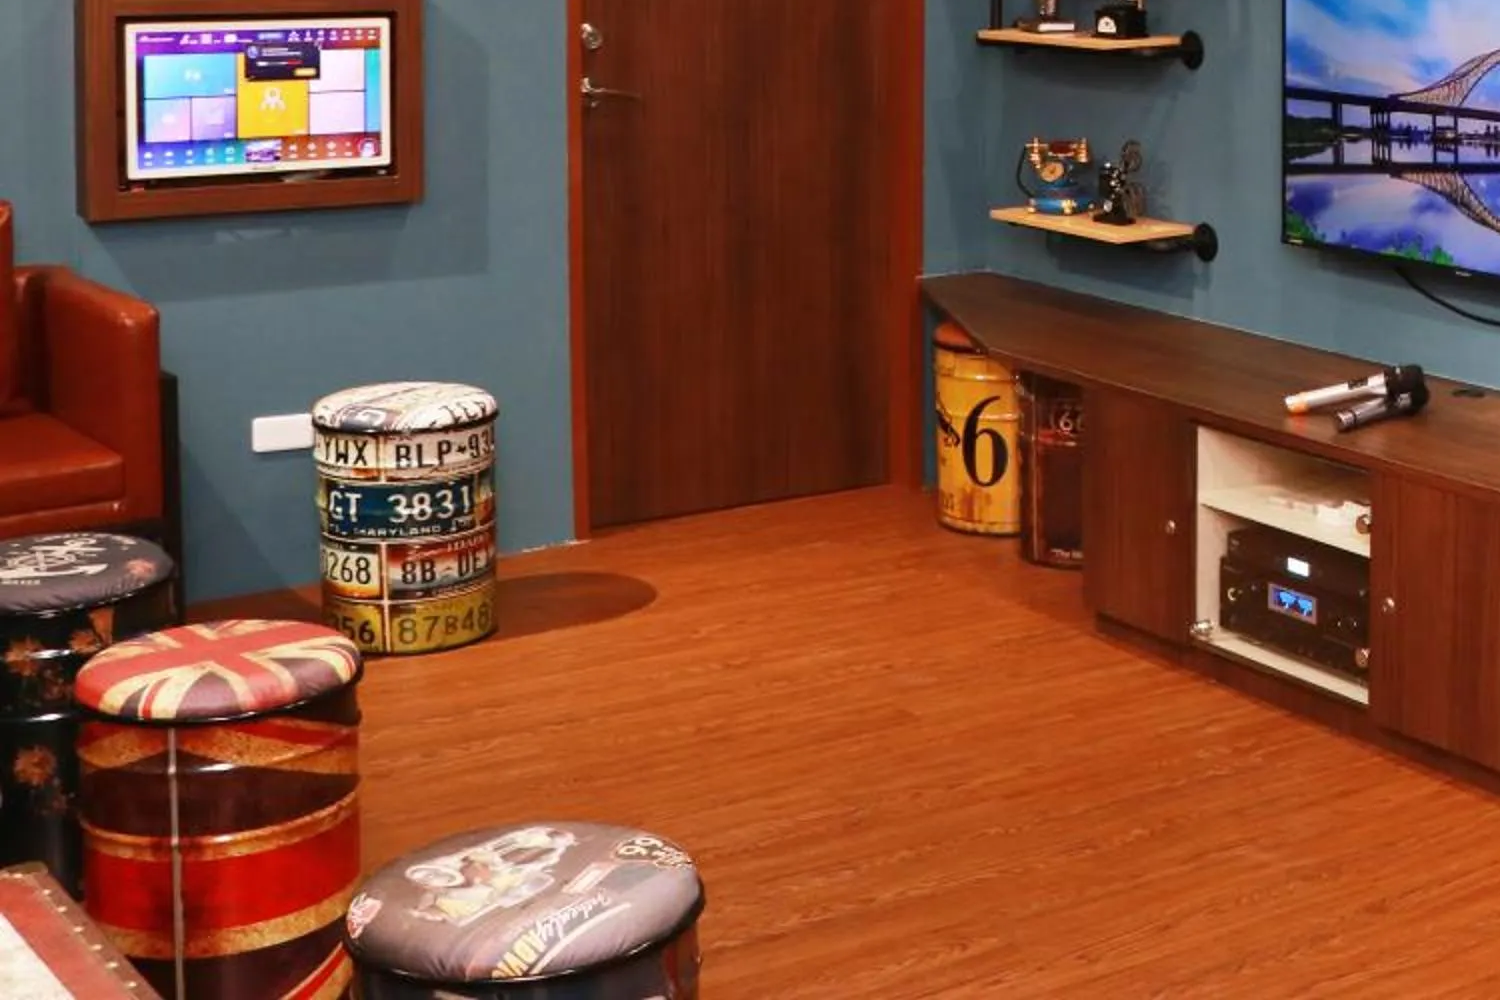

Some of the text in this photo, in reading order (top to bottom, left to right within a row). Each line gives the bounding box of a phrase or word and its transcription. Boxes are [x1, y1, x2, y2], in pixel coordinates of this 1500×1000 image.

[962, 395, 1009, 487] 6
[329, 485, 471, 524] GT 3831
